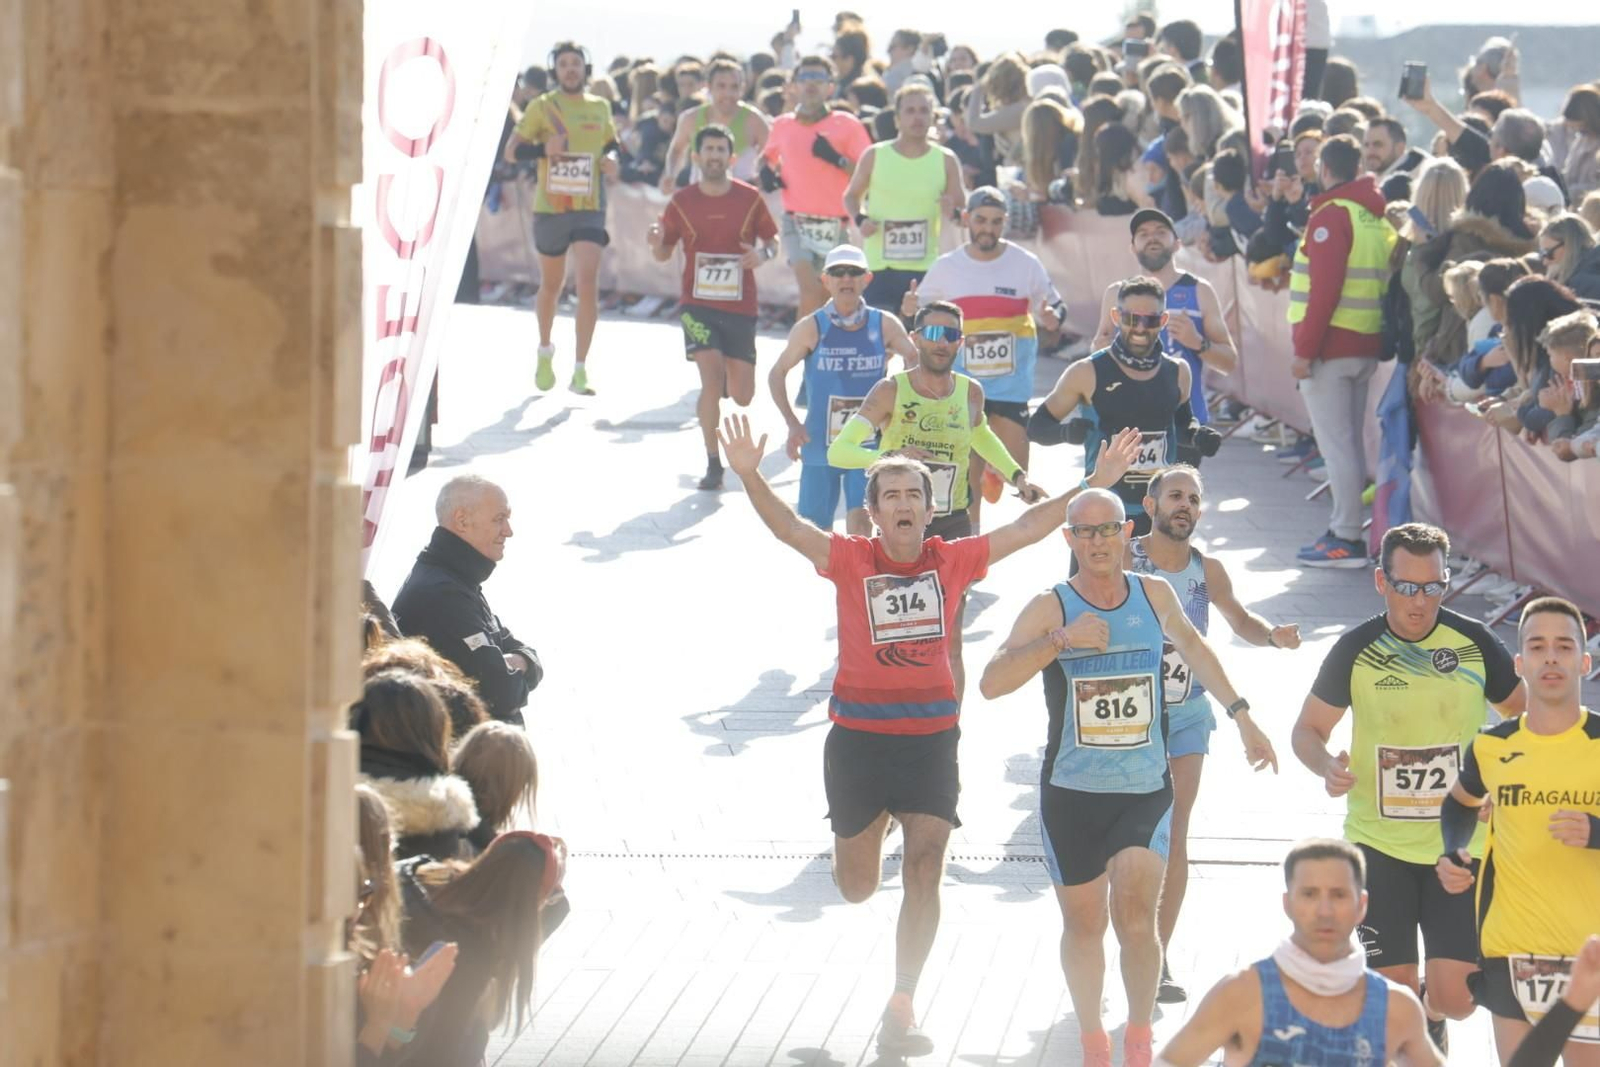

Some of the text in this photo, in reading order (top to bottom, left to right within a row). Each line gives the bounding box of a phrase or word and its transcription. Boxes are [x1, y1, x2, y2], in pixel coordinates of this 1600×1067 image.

[889, 232, 923, 245] 2831
[705, 268, 732, 282] 777
[970, 345, 1008, 360] 1360
[817, 357, 844, 371] AVE
[908, 437, 955, 450] Desguace
[886, 592, 926, 615] 314
[1072, 650, 1159, 675] MEDIA LEGU
[1094, 696, 1138, 719] 816
[1395, 767, 1447, 791] 572
